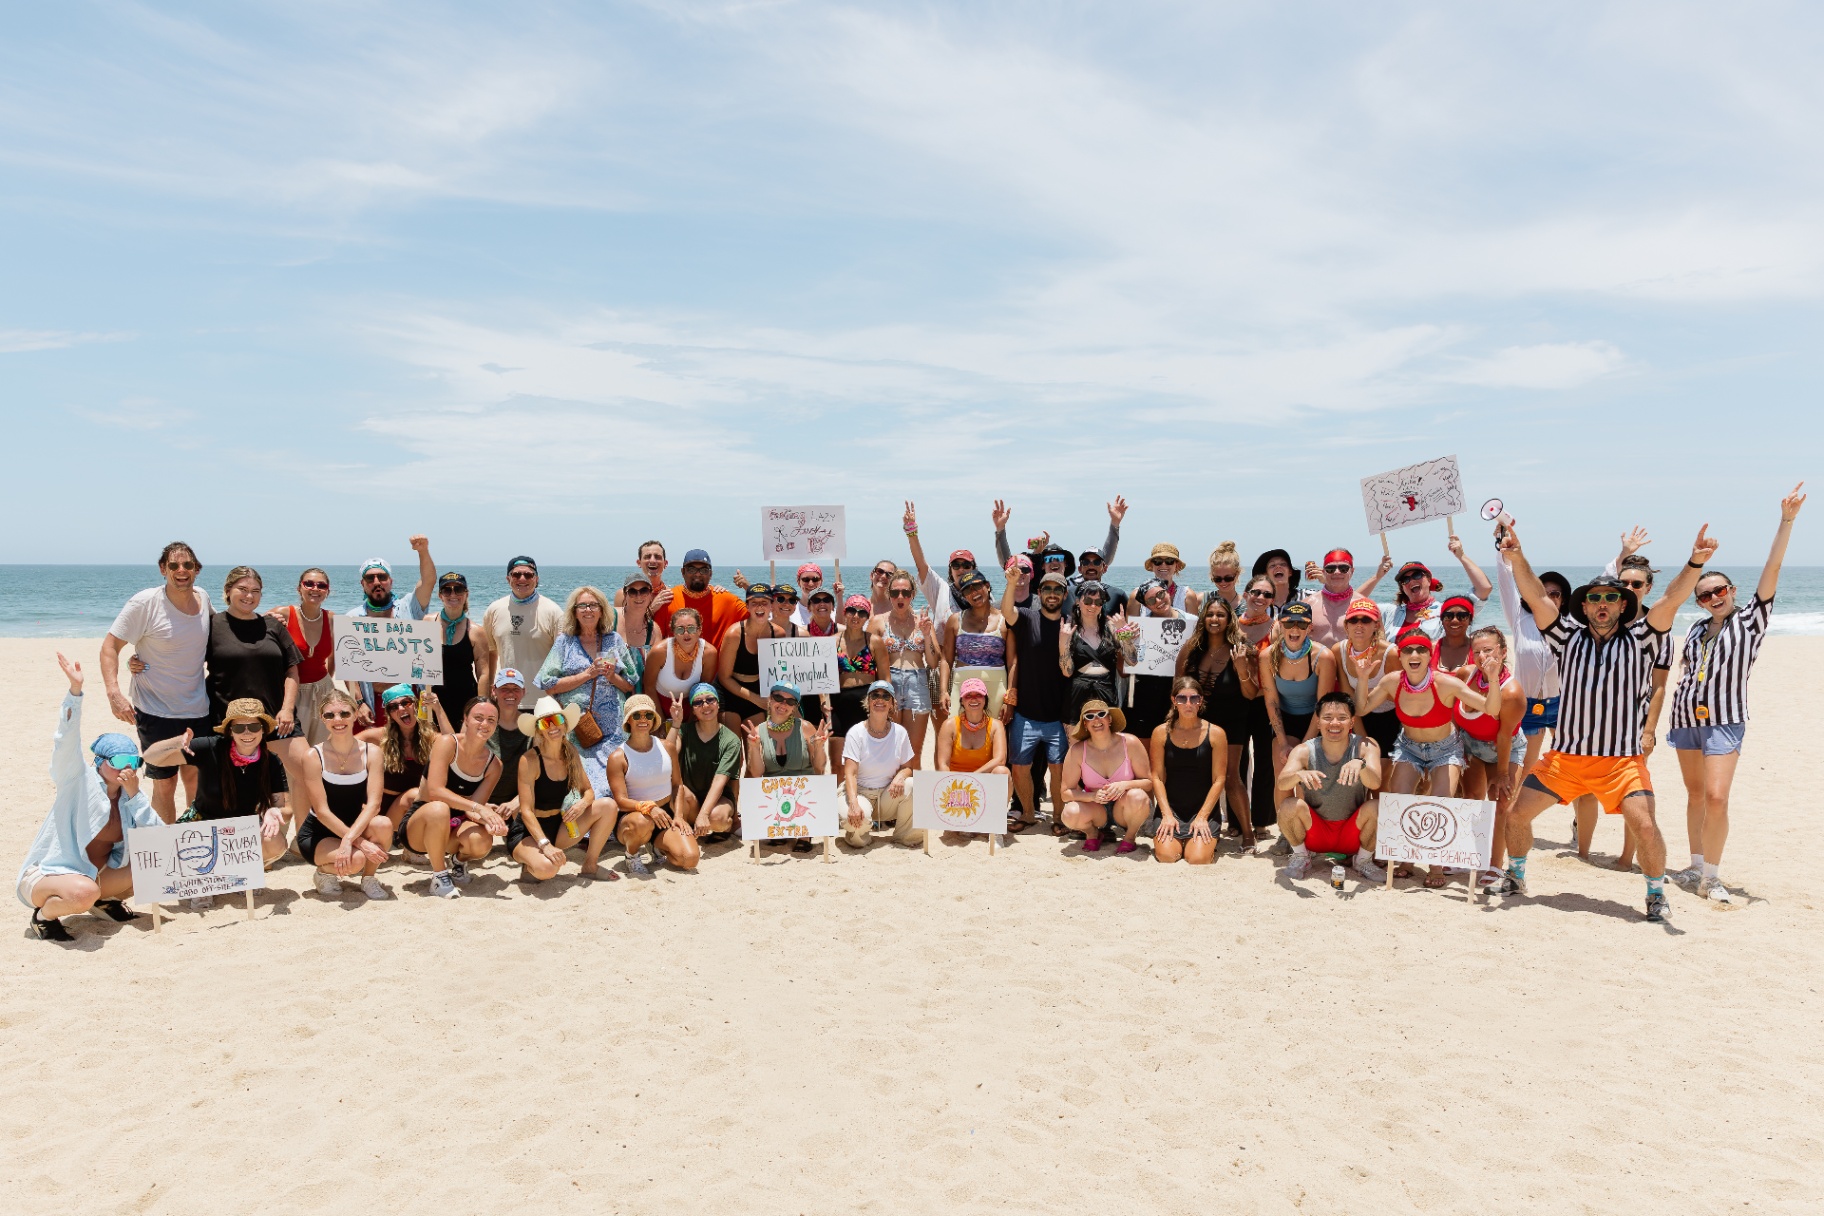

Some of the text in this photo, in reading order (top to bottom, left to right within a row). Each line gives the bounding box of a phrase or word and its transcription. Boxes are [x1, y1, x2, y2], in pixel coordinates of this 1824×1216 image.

[352, 621, 379, 634] THE
[363, 637, 434, 655] BLASTS
[770, 641, 820, 657] TEQUILA
[794, 777, 809, 790] IS
[767, 825, 809, 839] EXTRA
[221, 834, 258, 853] SKUBA
[134, 851, 162, 870] THE
[222, 849, 261, 866] DIVERS
[1380, 844, 1398, 857] THE
[1440, 850, 1482, 868] BEACHES
[179, 888, 199, 898] CABO
